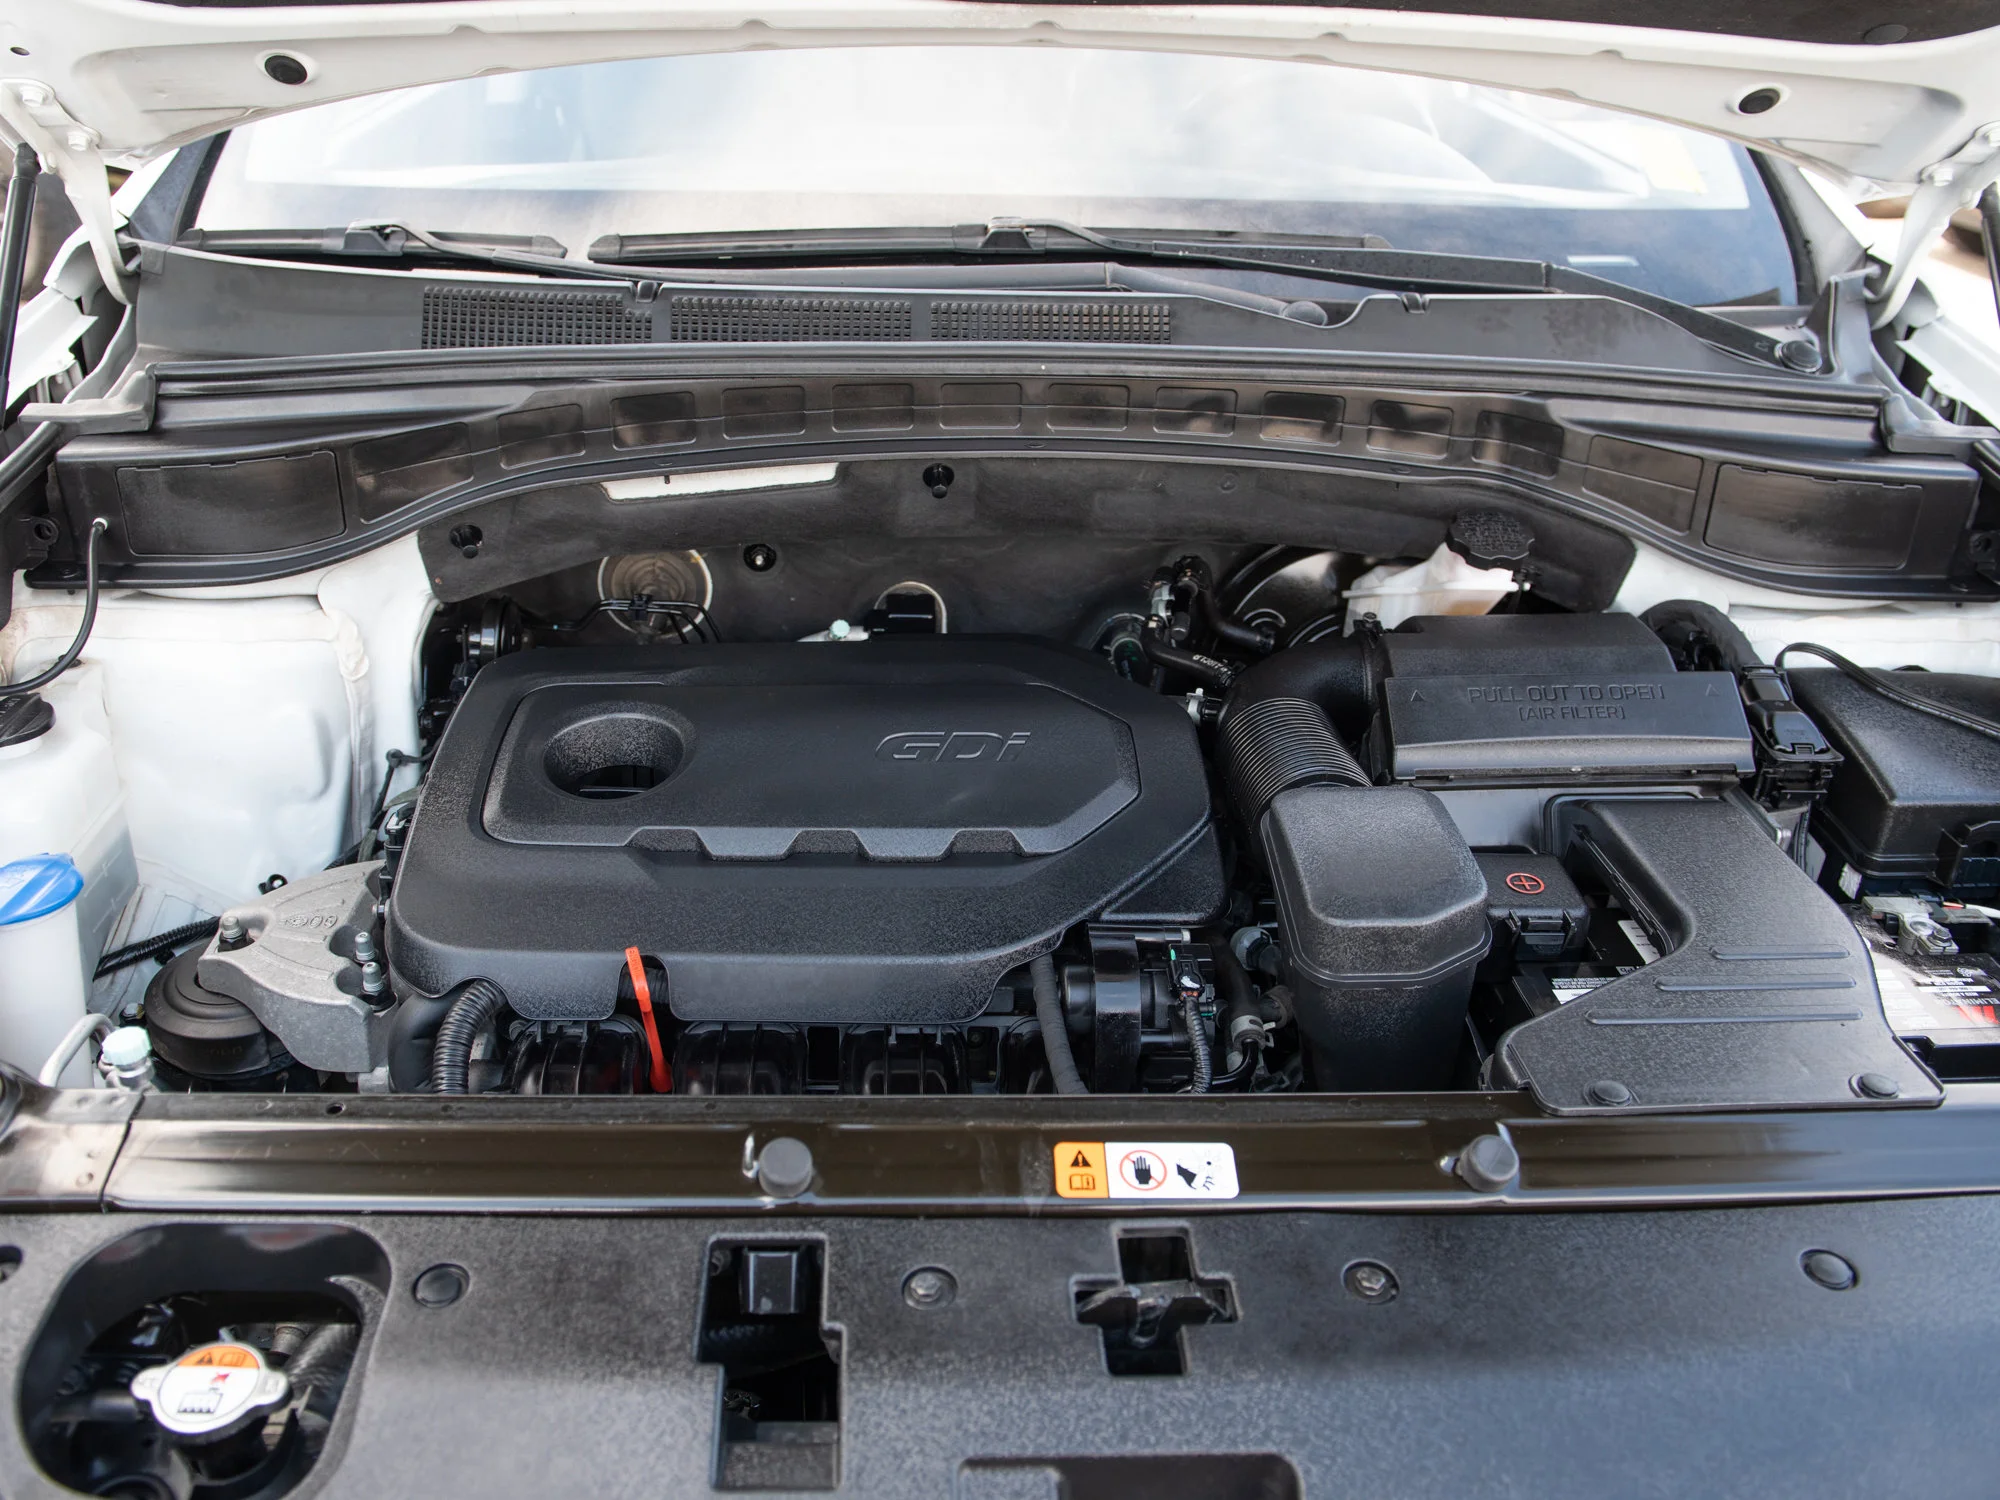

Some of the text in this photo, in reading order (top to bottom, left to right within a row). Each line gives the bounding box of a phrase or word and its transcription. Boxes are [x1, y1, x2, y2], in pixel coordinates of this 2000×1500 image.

[1467, 683, 1665, 703] PULL OUT TO OPEN
[875, 731, 1031, 762] GDi
